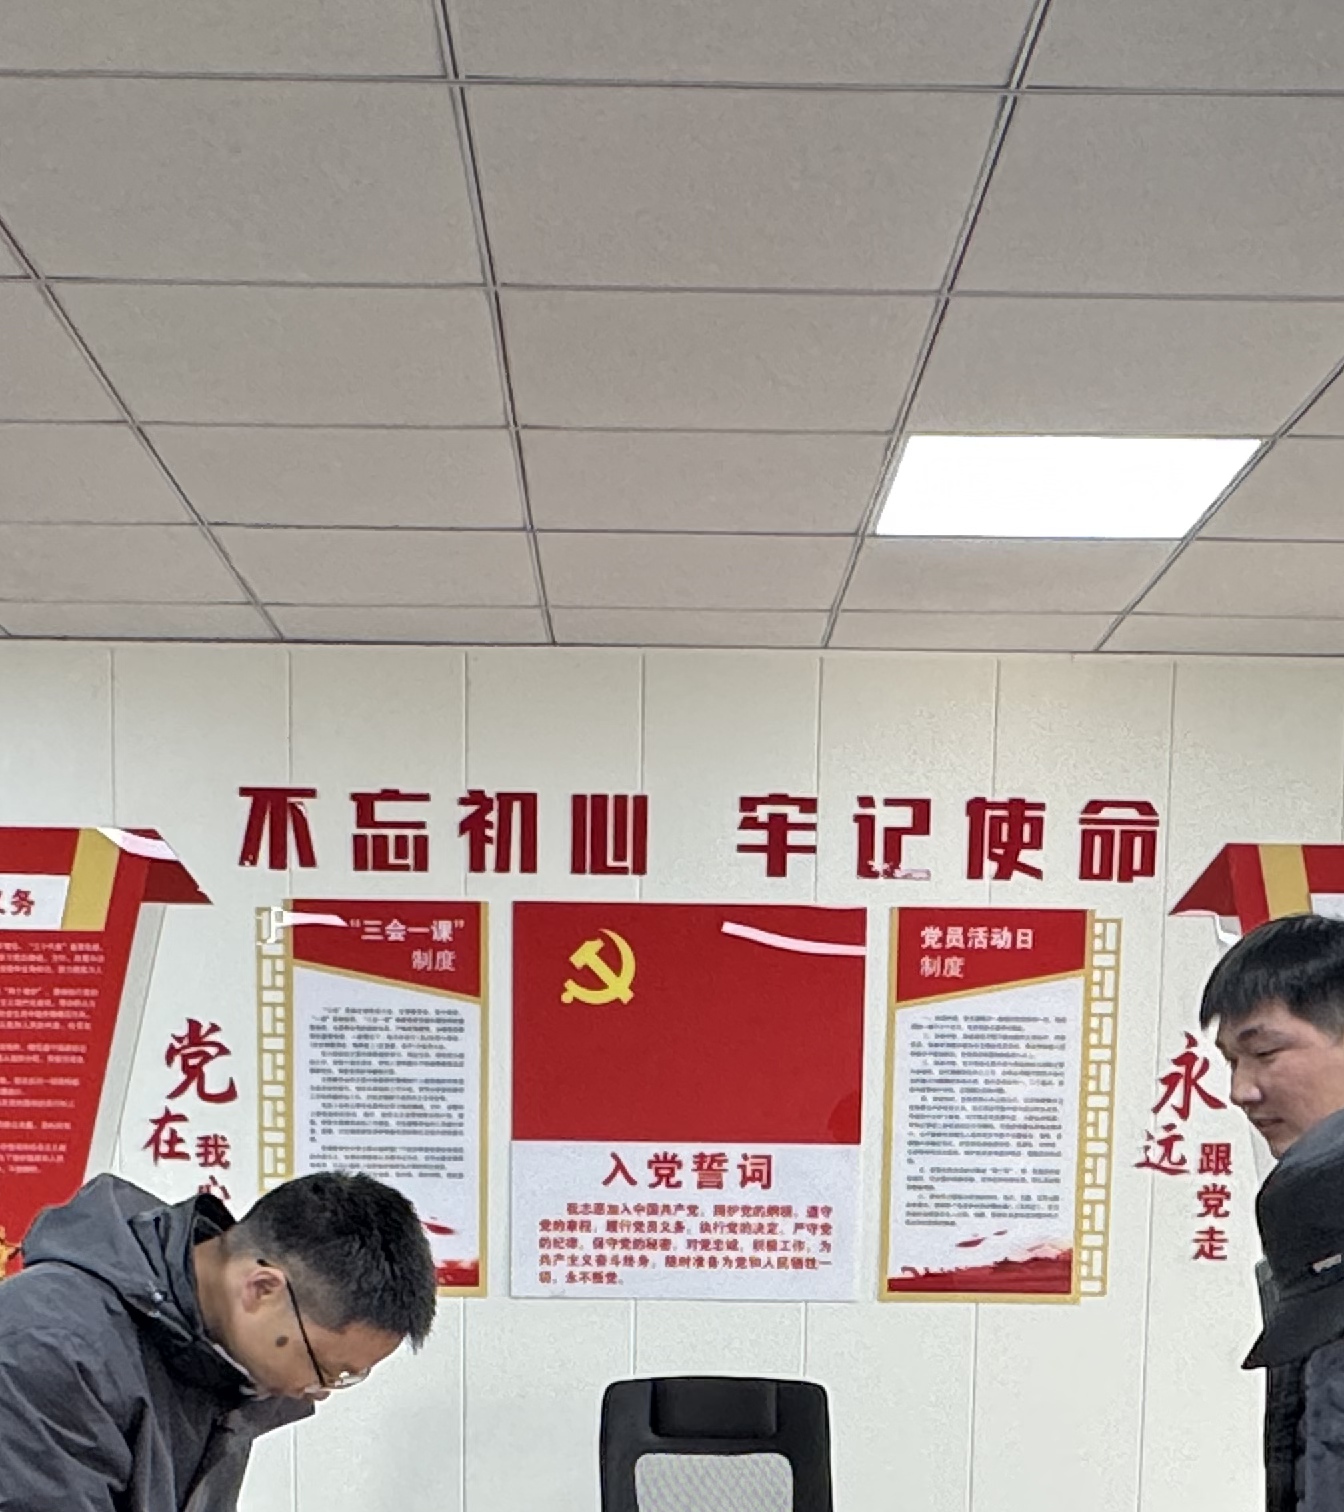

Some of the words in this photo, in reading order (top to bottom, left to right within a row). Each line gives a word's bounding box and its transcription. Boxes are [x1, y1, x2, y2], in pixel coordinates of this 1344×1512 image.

[920, 925, 1034, 949] 党员活动日
[412, 949, 457, 972] 制度
[920, 955, 965, 978] 制度
[602, 1151, 774, 1190] 入党誓词
